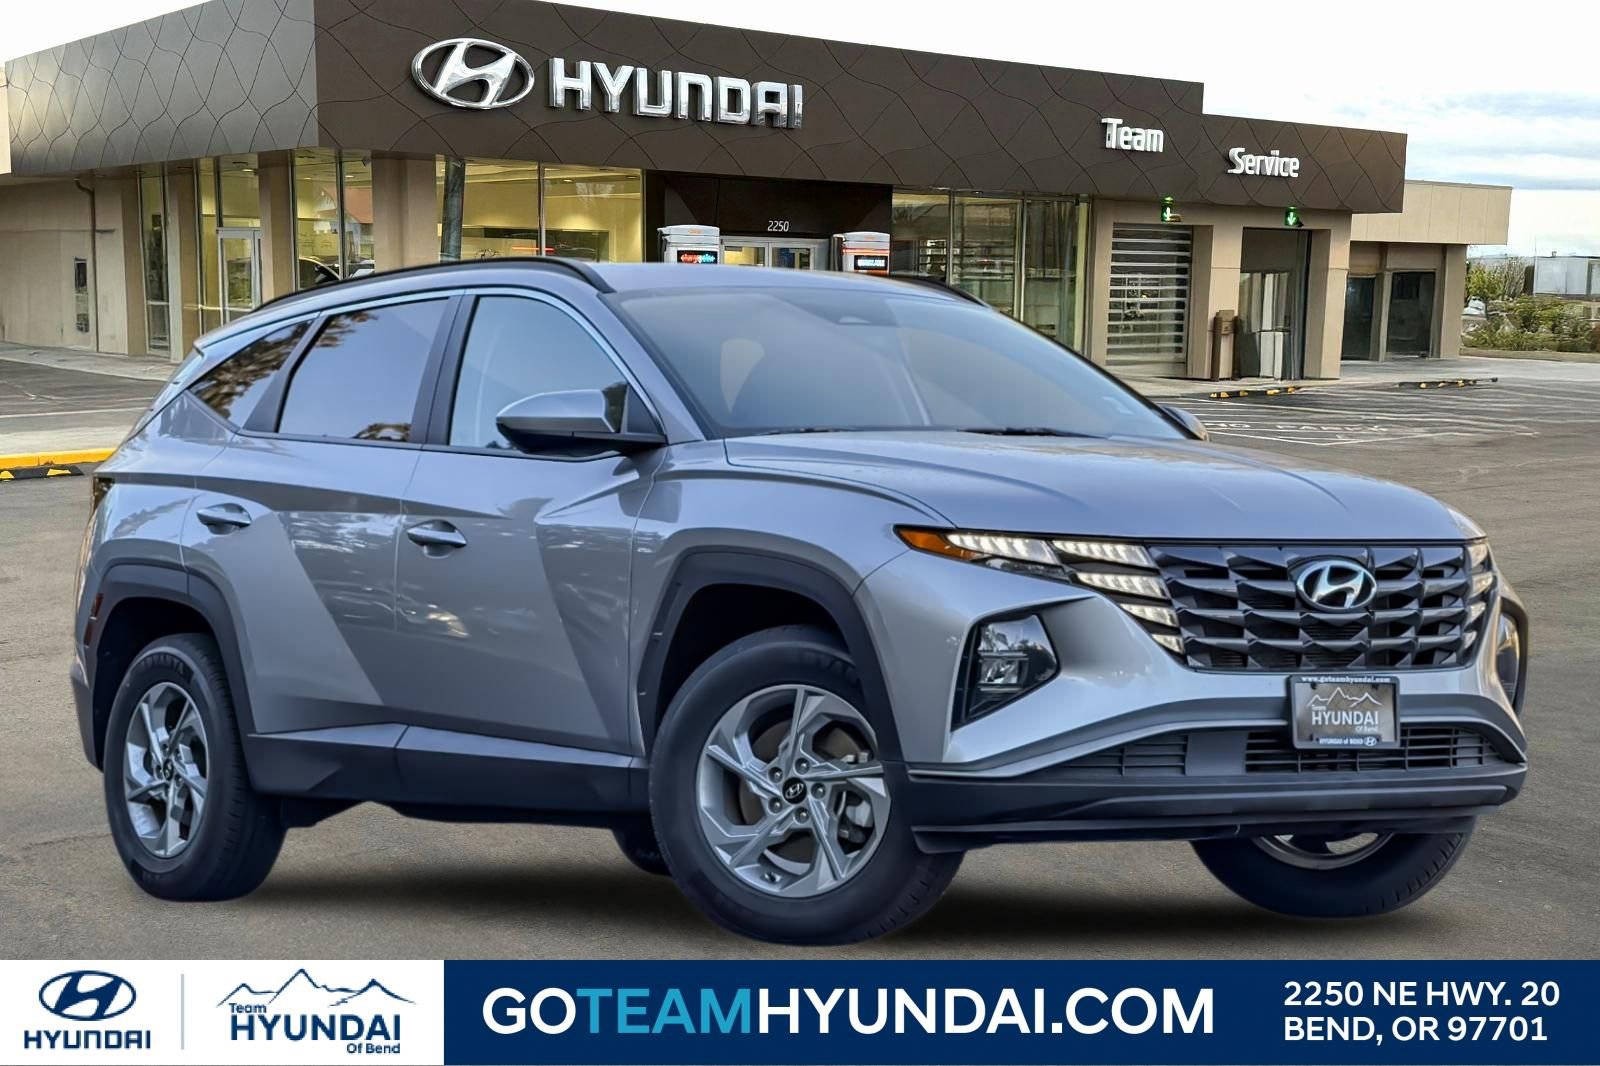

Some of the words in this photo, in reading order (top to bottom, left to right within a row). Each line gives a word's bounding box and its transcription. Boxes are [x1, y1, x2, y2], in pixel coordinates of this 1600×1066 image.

[549, 57, 804, 128] HYUNDAI
[1102, 117, 1164, 153] Team
[1227, 147, 1300, 178] Service
[767, 220, 790, 232] 2250
[1312, 711, 1378, 725] HYUNDAI
